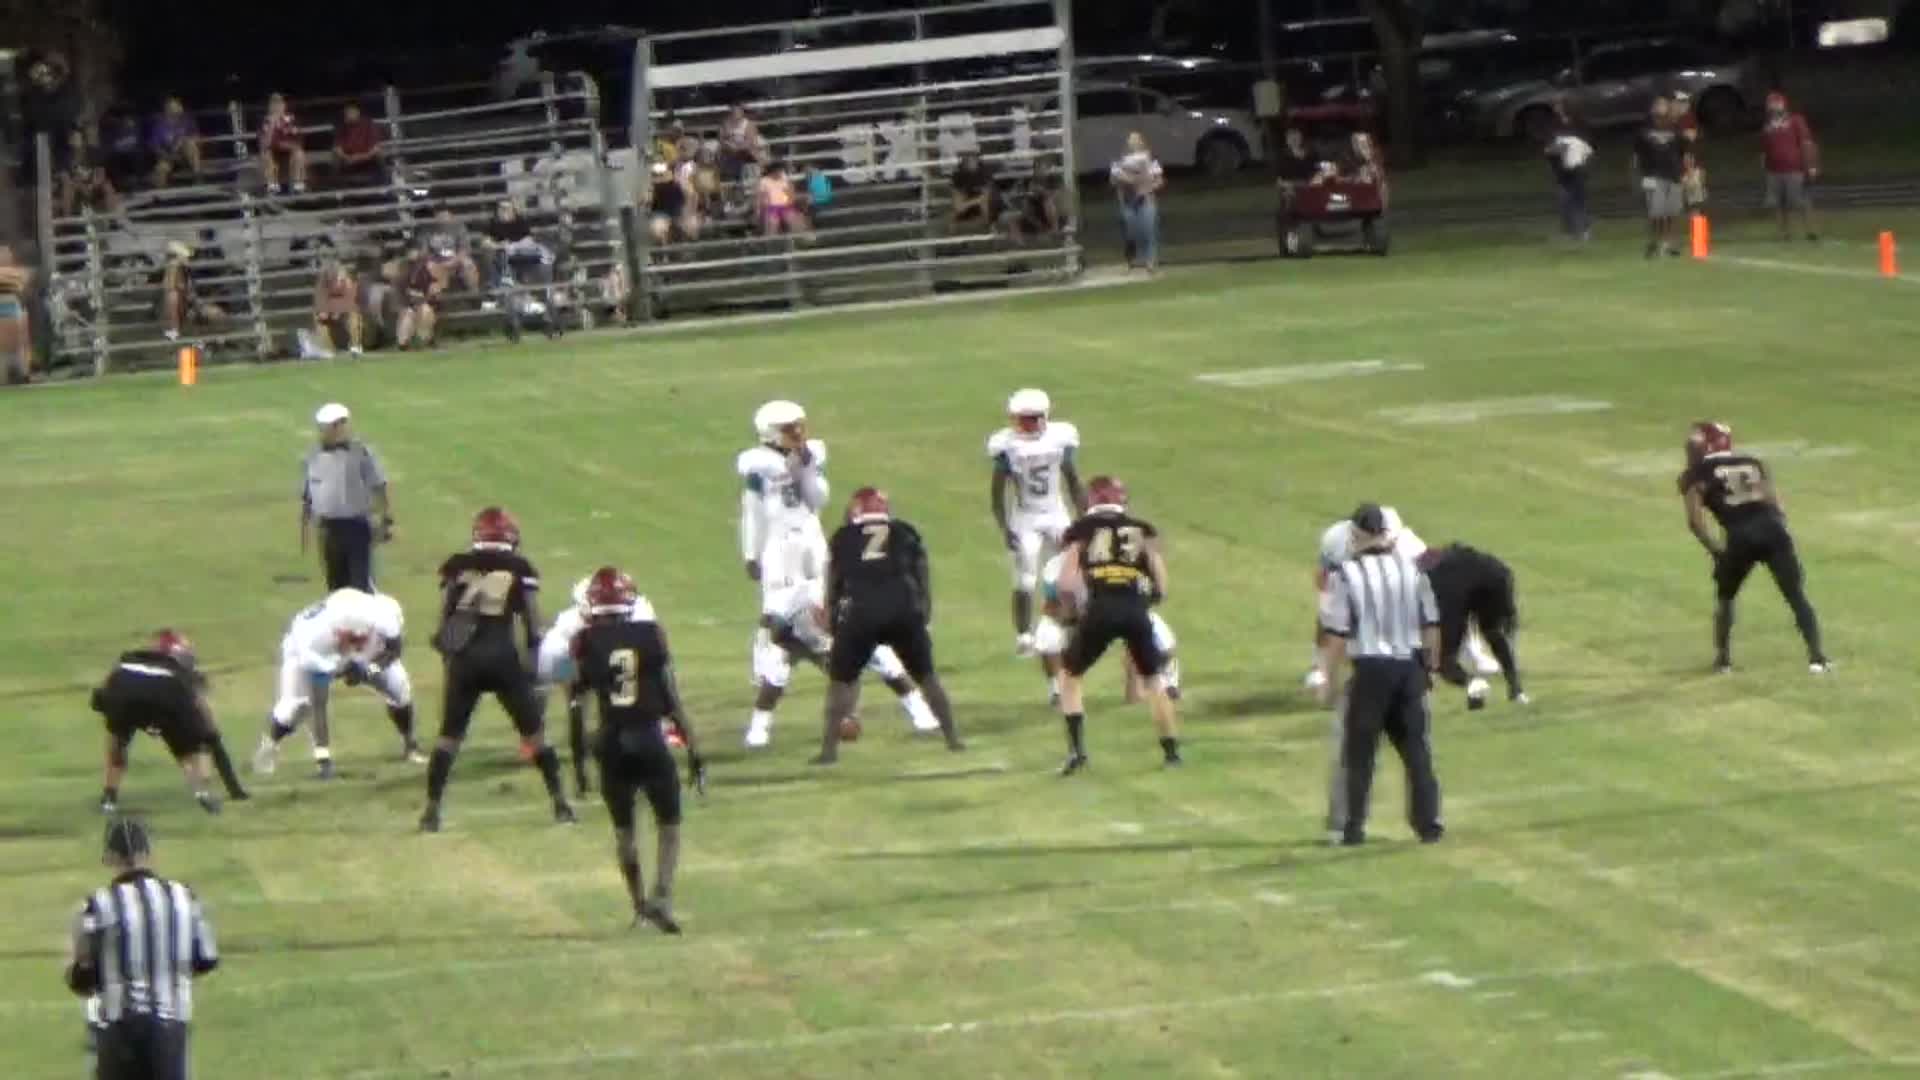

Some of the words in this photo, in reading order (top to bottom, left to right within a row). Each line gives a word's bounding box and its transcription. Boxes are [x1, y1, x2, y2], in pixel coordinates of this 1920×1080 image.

[861, 525, 889, 561] 2
[1088, 527, 1143, 563] 43
[608, 648, 640, 706] 3
